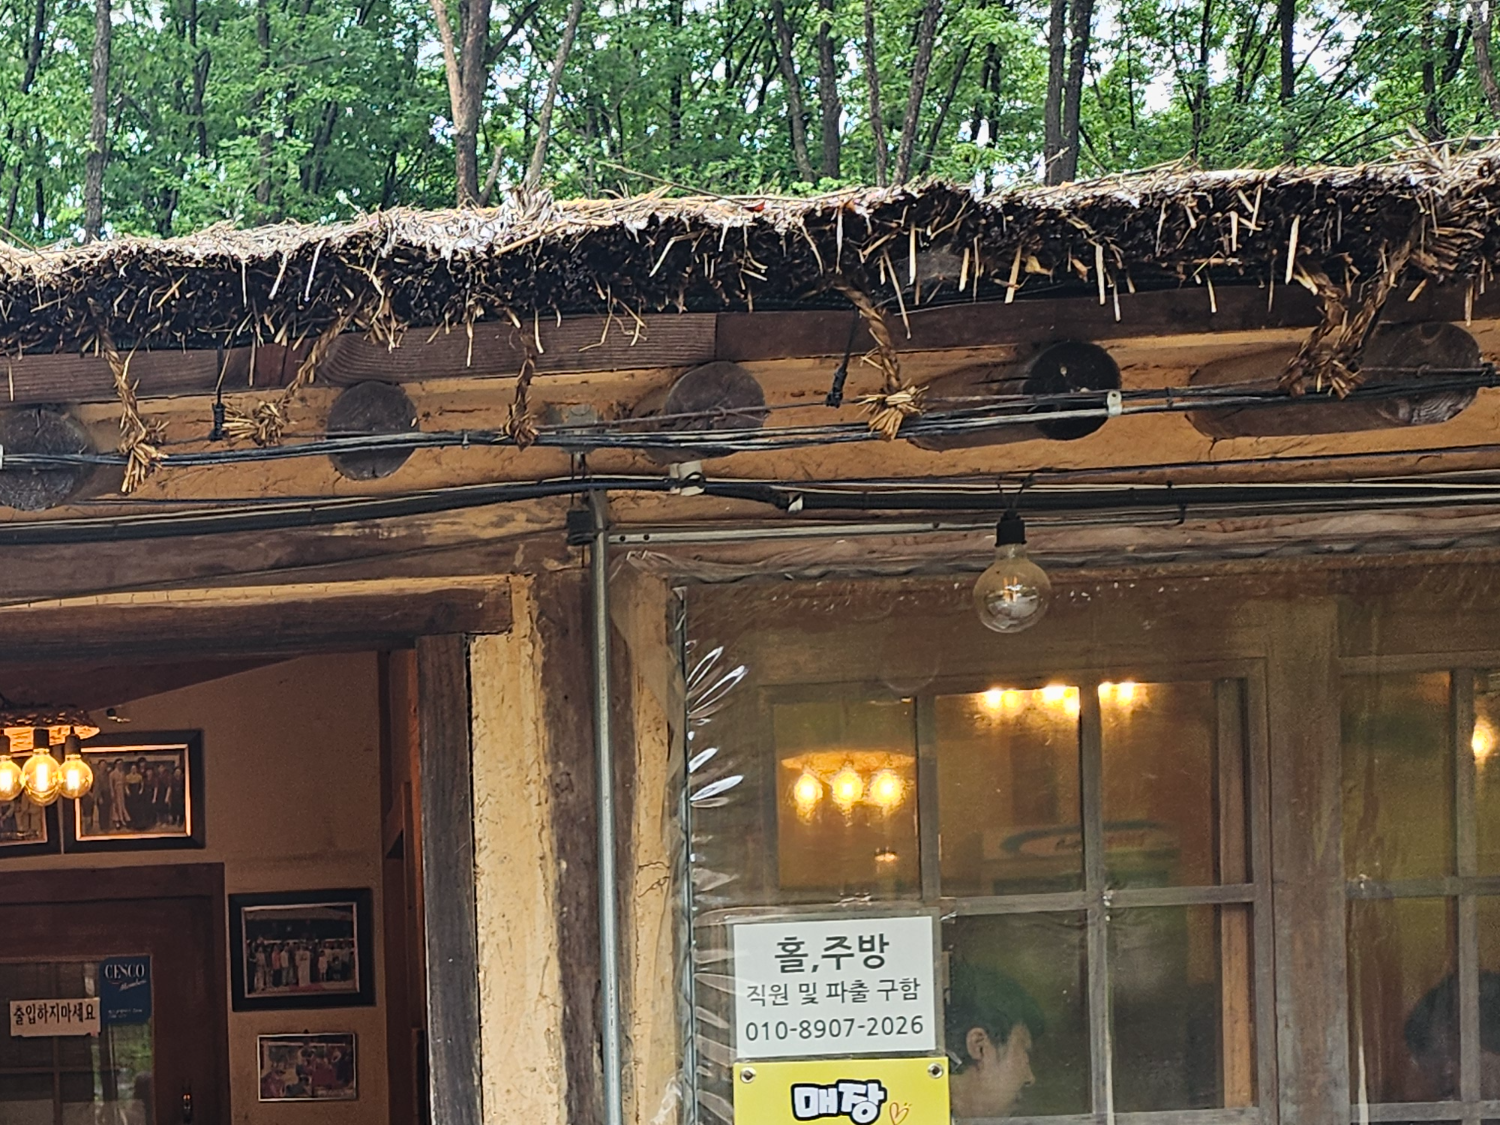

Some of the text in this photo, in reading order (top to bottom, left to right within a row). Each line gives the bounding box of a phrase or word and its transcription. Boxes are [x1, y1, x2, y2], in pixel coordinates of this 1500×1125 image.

[774, 933, 890, 974] 홀,주방
[104, 963, 146, 980] CESCO
[746, 977, 921, 1007] 직원 및 파출 구함
[13, 1002, 97, 1026] 출입하지마세요
[745, 1015, 924, 1042] 010-8907-2026
